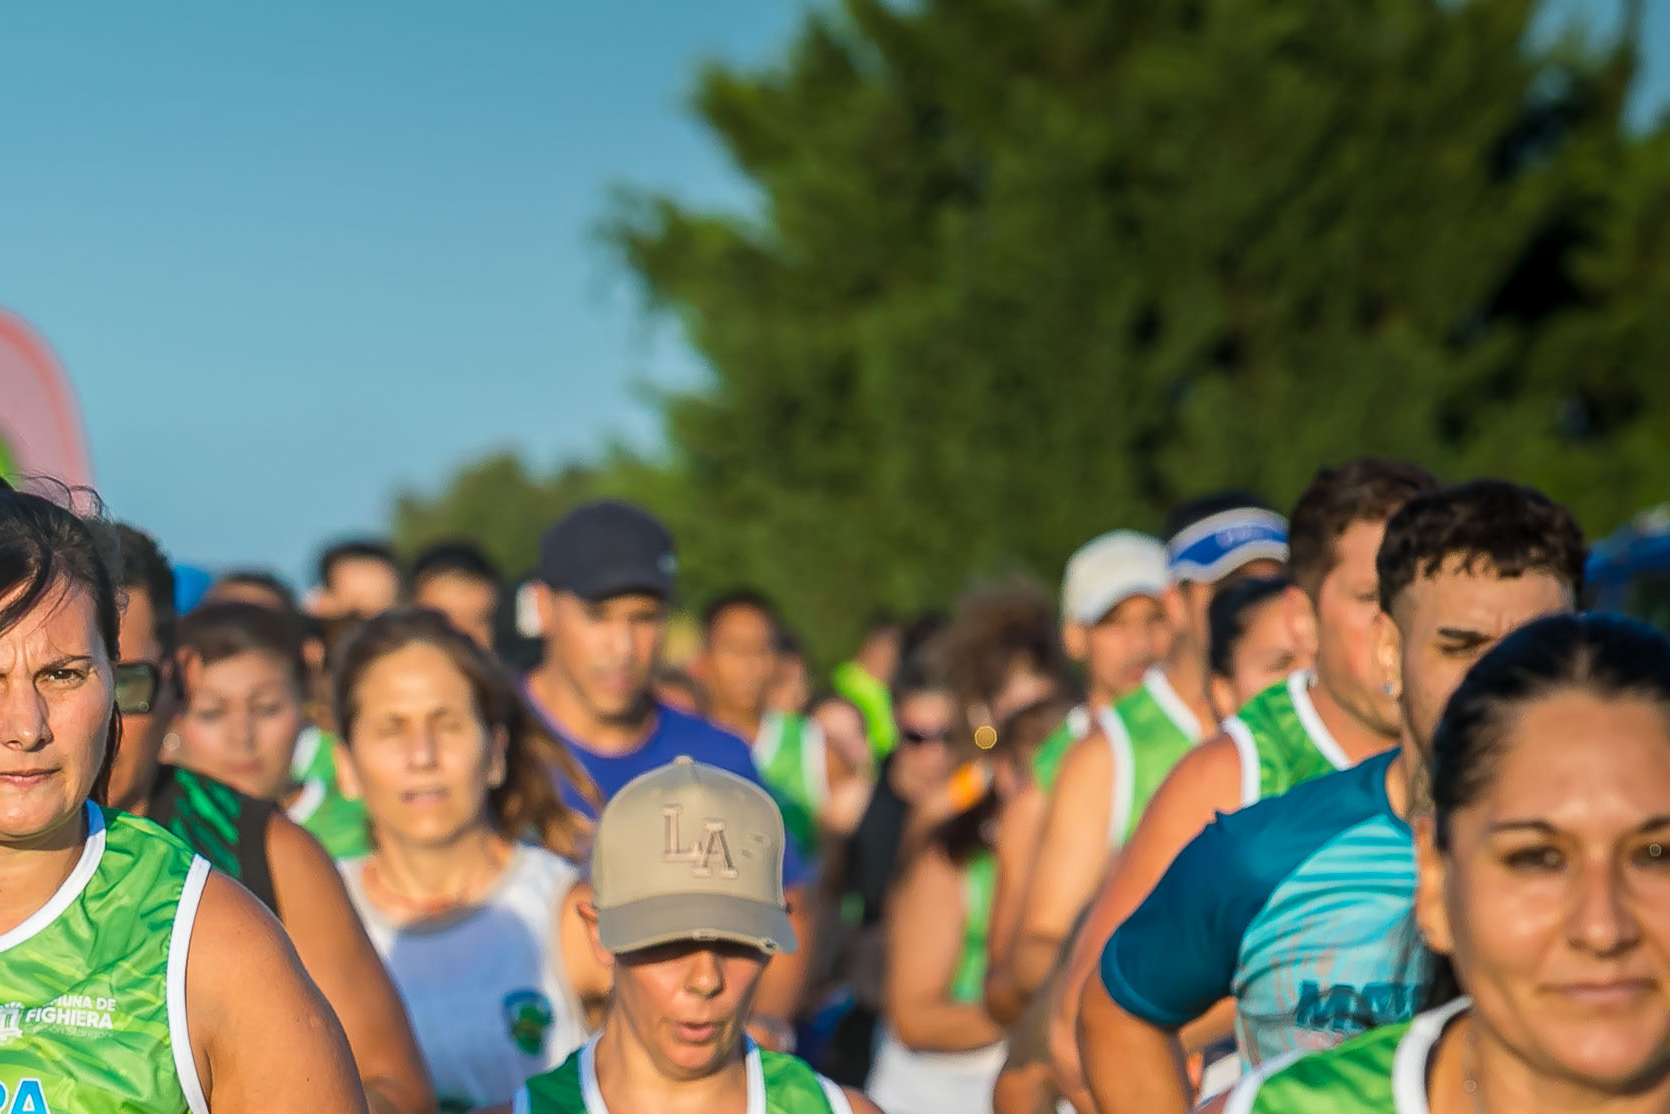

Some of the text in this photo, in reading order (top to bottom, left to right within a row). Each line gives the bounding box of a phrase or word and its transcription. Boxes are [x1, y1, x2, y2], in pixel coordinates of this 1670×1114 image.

[661, 803, 738, 879] LA
[96, 997, 117, 1012] DE
[25, 1007, 114, 1029] FIGHIERA
